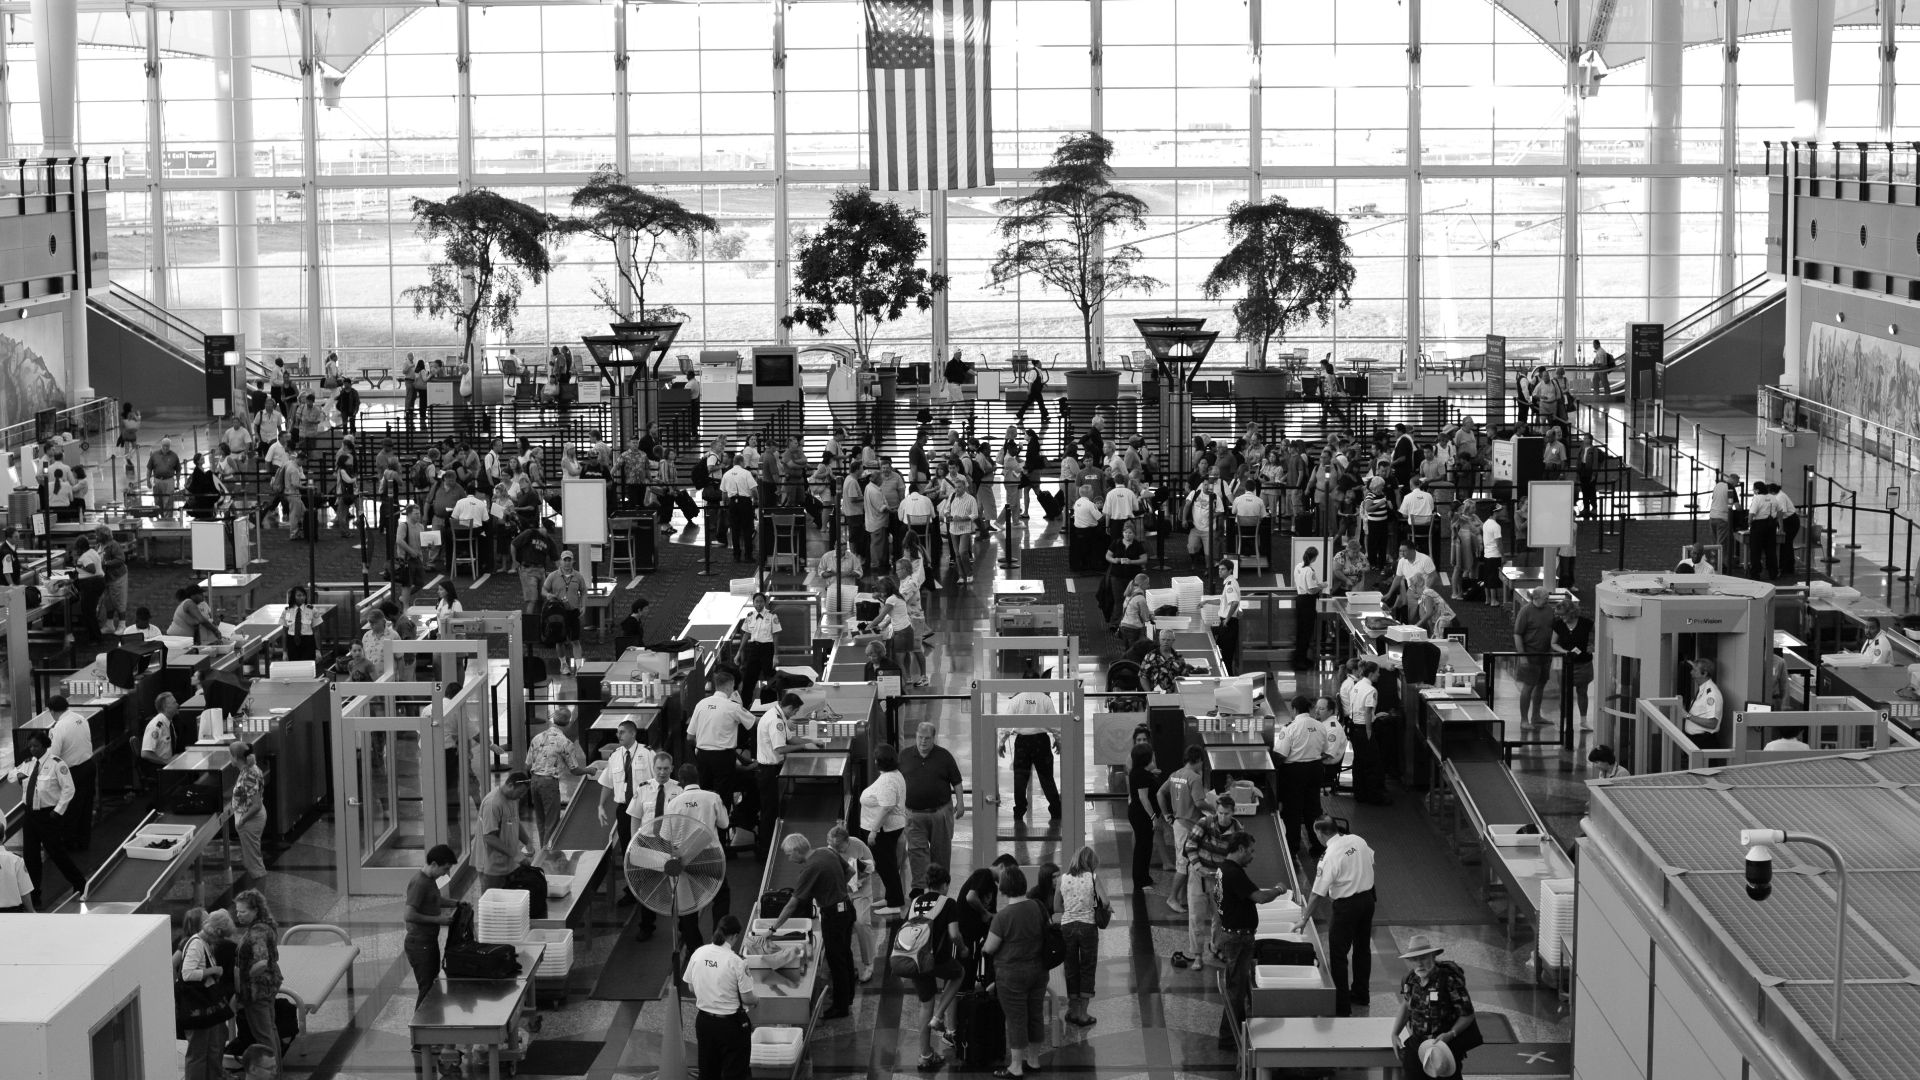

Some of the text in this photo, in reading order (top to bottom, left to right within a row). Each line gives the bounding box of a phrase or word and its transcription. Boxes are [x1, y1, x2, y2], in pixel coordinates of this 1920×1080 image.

[330, 683, 336, 691] 4
[436, 683, 441, 692] 5
[971, 680, 977, 689] 6
[1078, 679, 1084, 688] 7
[1736, 713, 1742, 723] 8
[1881, 712, 1887, 722] 9
[1345, 847, 1357, 857] TSA
[704, 959, 718, 969] TSA
